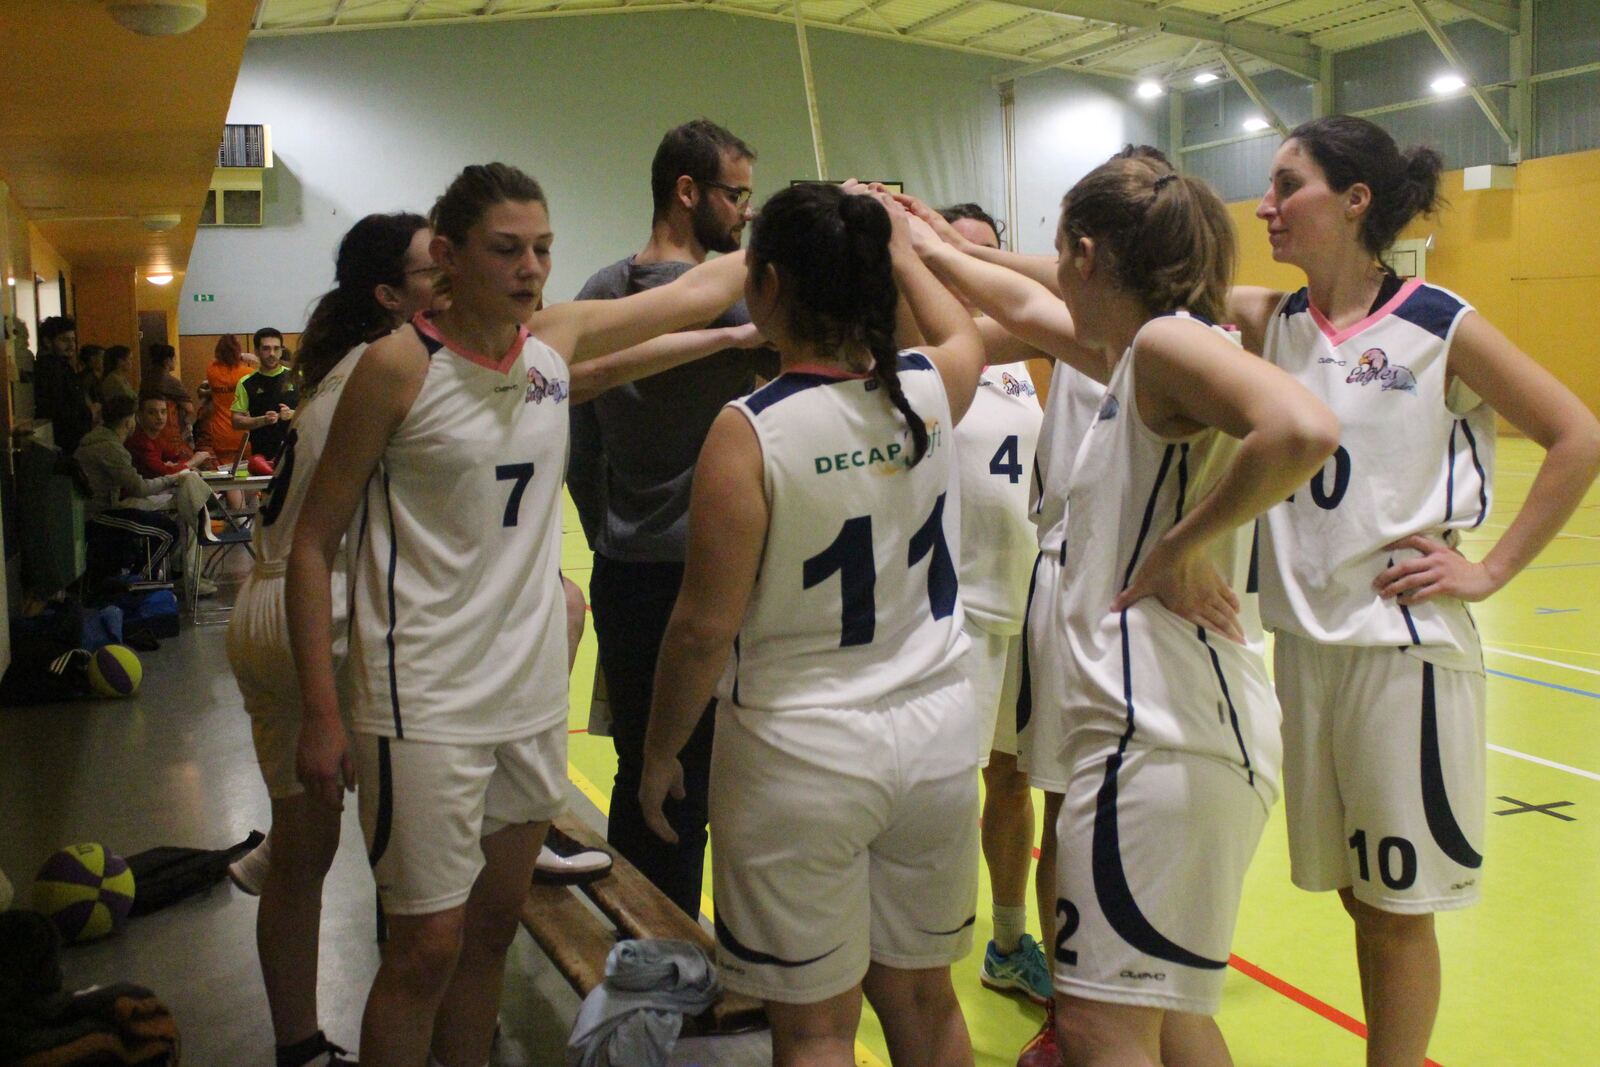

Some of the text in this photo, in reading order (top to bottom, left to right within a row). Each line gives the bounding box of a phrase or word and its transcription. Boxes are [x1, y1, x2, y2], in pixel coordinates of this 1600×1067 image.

[989, 435, 1023, 484] 4
[495, 462, 535, 528] 7
[803, 490, 959, 648] 11
[1348, 829, 1417, 891] 10
[1055, 897, 1080, 967] 2
